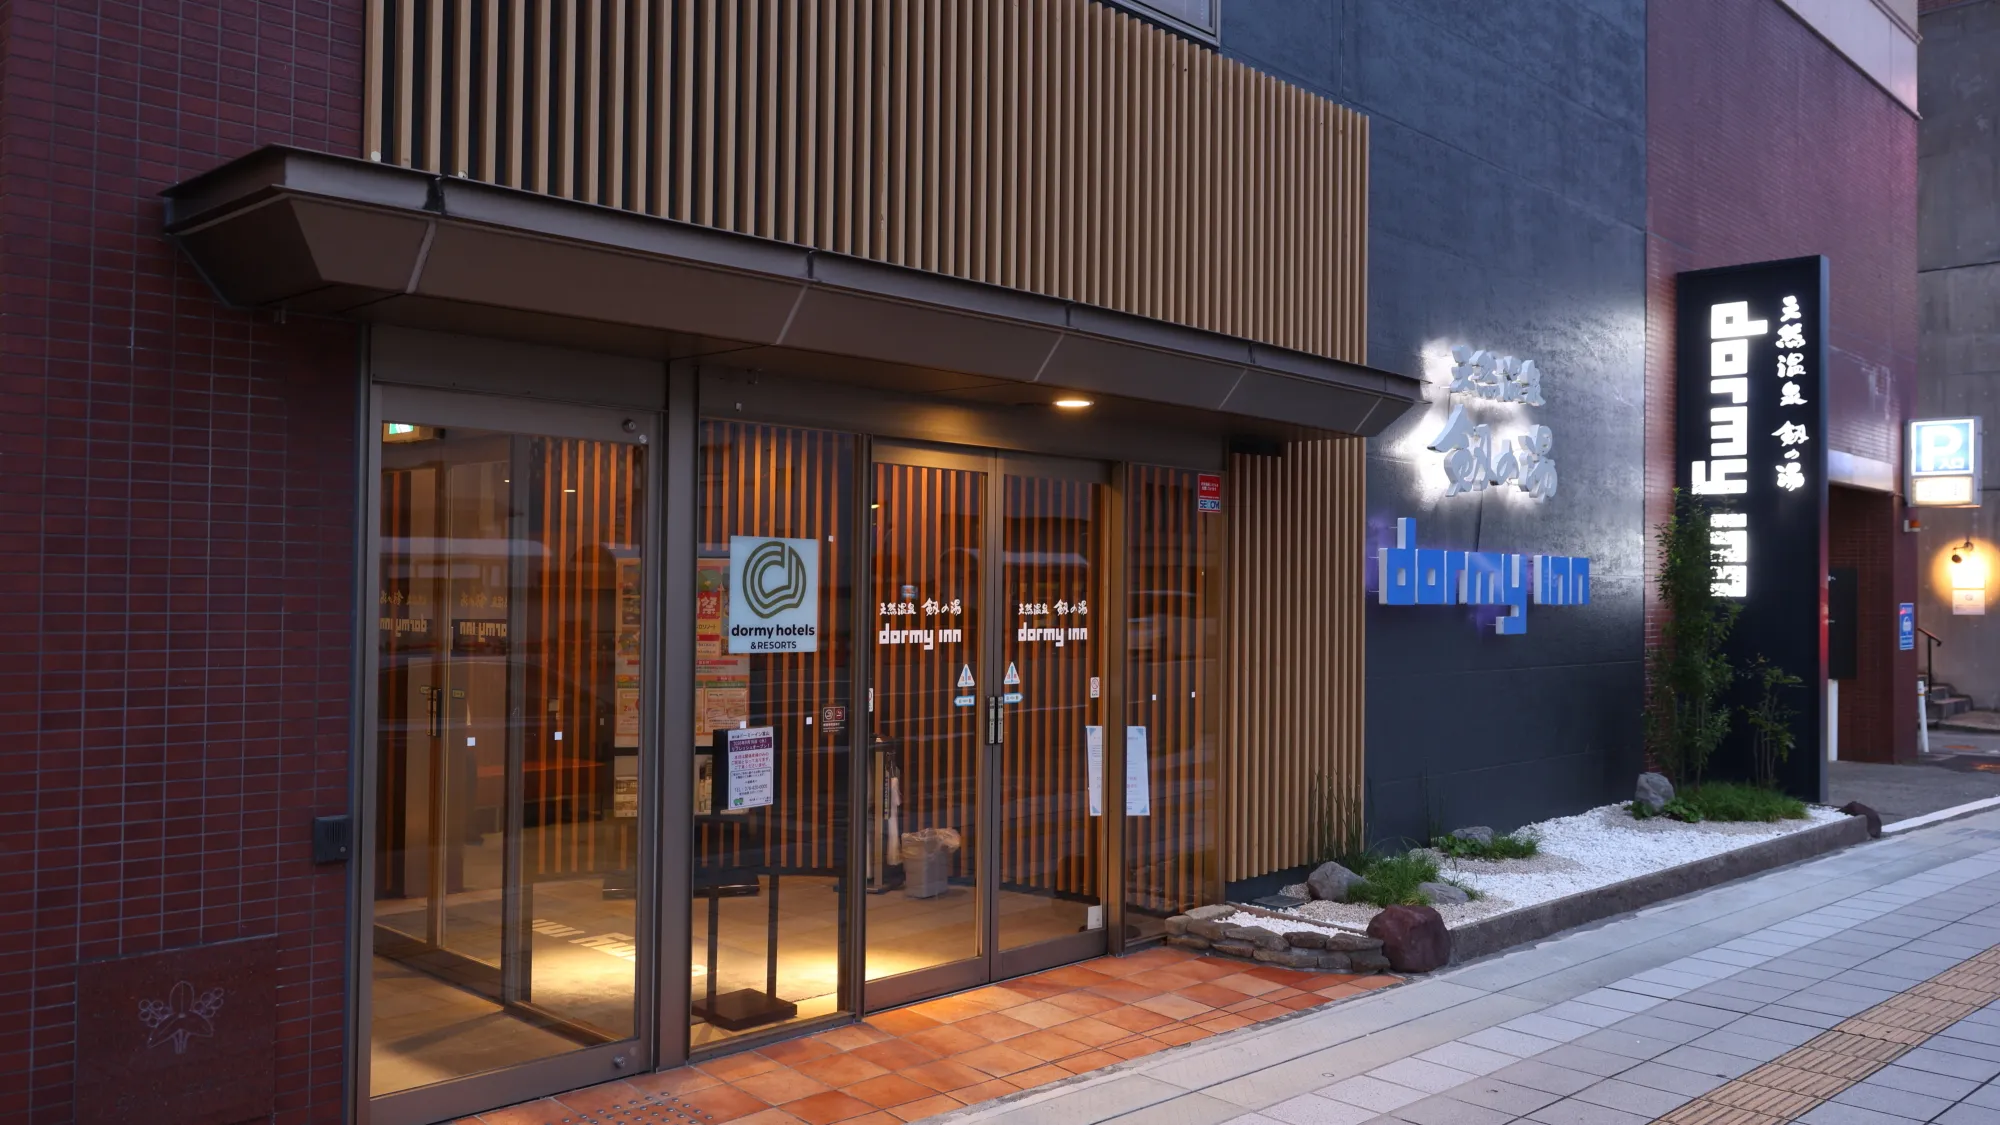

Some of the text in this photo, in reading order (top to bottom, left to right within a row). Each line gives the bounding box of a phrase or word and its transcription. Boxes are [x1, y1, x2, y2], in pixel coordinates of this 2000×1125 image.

[1775, 295, 1807, 406] 天然温泉
[1692, 301, 1768, 598] dormy inn
[1920, 425, 1963, 472] P
[1379, 518, 1590, 634] dormy inn
[880, 602, 917, 616] 天然温泉
[731, 624, 815, 639] dormy hotels
[879, 623, 962, 650] dormy inn
[1018, 622, 1088, 647] dormy inn
[750, 641, 797, 650] & RESORTS
